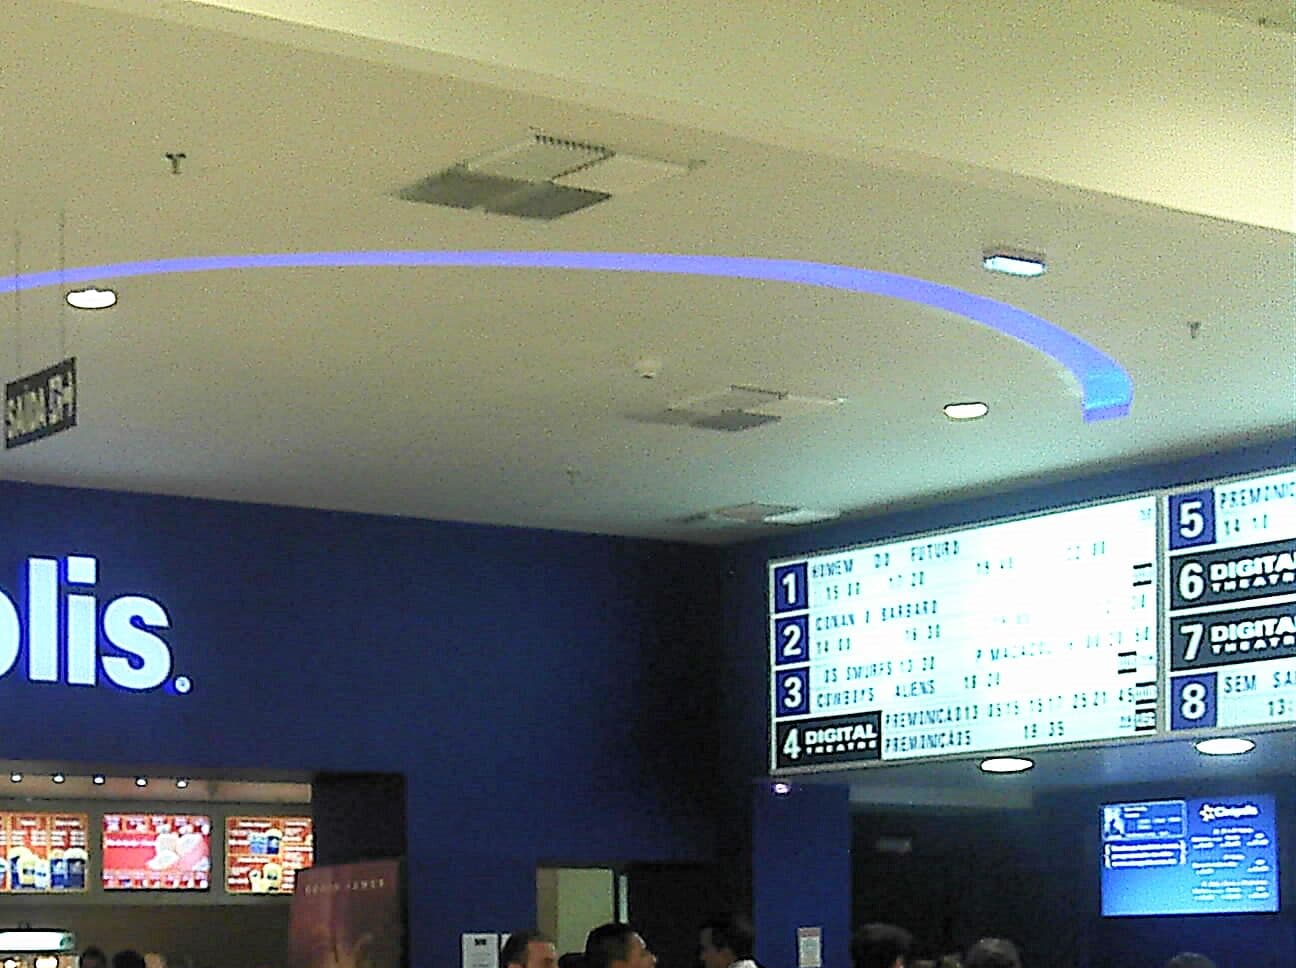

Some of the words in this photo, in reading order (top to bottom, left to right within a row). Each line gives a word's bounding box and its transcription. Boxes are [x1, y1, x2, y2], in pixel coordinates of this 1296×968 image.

[1179, 501, 1204, 538] 5
[782, 572, 797, 604] 1
[1179, 562, 1204, 600] 6
[1210, 552, 1296, 580] DIGITA
[783, 624, 802, 656] 2
[1180, 623, 1204, 660] 7
[1210, 616, 1296, 643] DIGITA
[784, 676, 802, 708] 3
[1181, 683, 1206, 720] 8
[783, 728, 802, 760] 4
[805, 723, 878, 745] DIGITAL
